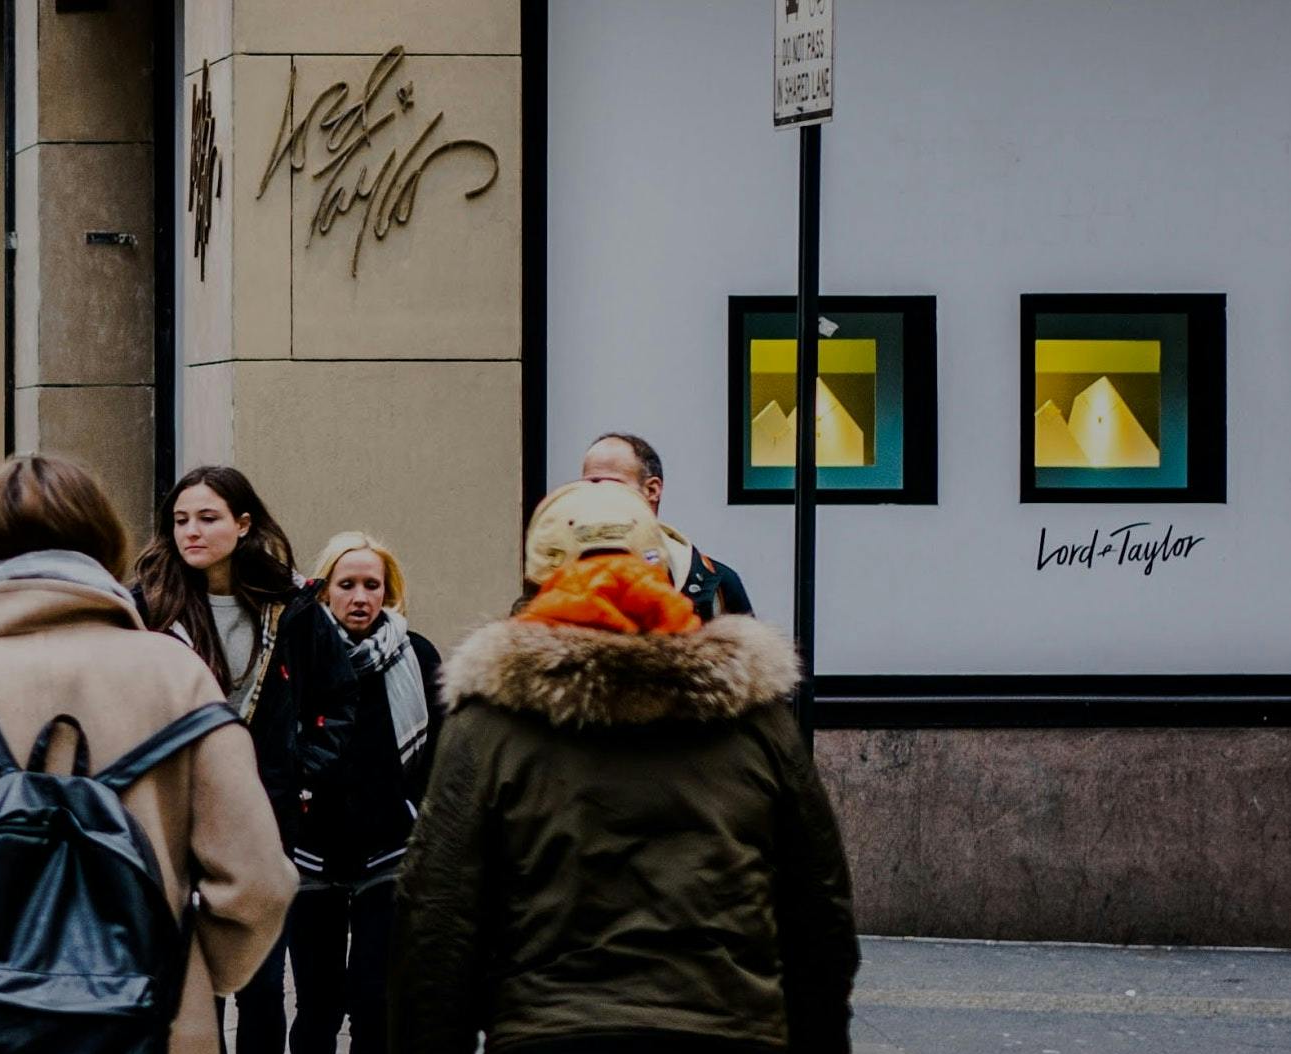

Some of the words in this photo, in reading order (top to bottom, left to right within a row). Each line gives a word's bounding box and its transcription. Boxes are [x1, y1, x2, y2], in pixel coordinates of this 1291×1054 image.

[792, 31, 805, 63] NOT
[807, 27, 824, 60] PASS
[785, 72, 809, 104] SHARED
[811, 67, 830, 100] LANE
[1037, 527, 1099, 571] Lord
[1110, 522, 1205, 576] Taylor
